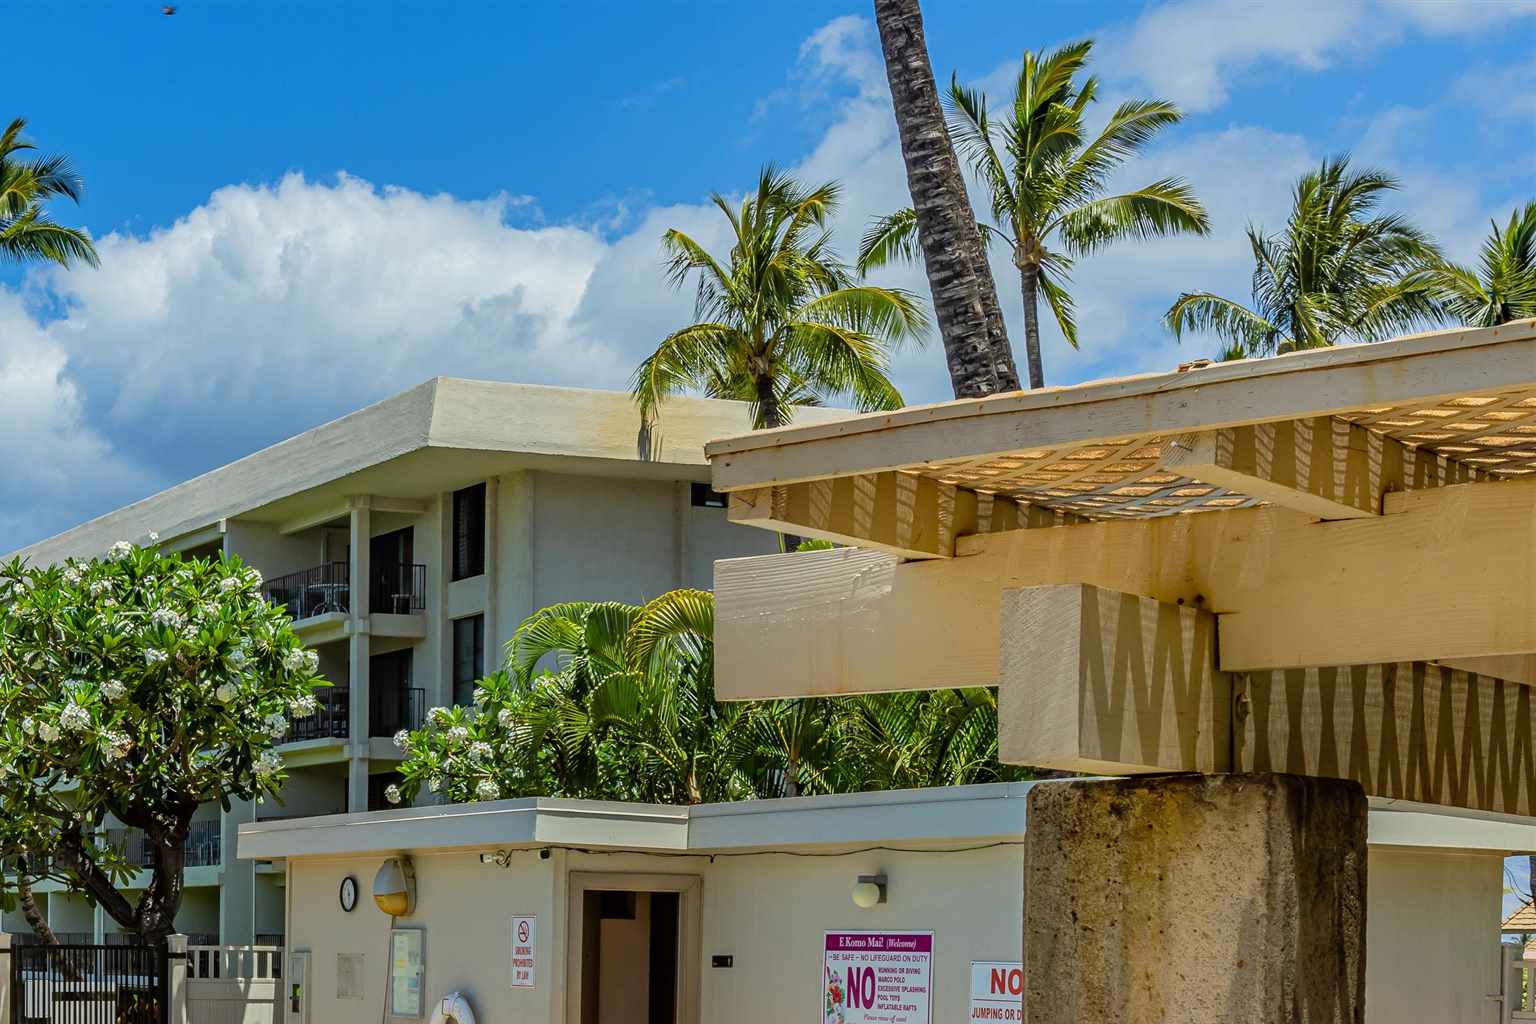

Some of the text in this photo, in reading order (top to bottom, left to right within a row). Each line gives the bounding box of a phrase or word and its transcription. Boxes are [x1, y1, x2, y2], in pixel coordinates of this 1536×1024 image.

[845, 936, 867, 948] Komo
[886, 937, 917, 951] (Welcome)
[841, 953, 854, 961] SAFE
[860, 953, 869, 962] NO
[870, 953, 902, 963] LIFEGUARD
[902, 954, 912, 963] ON
[912, 954, 929, 963] DUTY
[990, 968, 1024, 996] NO
[846, 966, 876, 1010] NO
[877, 985, 927, 994] EXCESSIVE SPLASHING
[877, 994, 901, 1003] POOL TOYS
[877, 1003, 918, 1012] INFLATABLE RAFTS
[971, 1007, 1003, 1019] JUMPING
[1004, 1008, 1015, 1020] OR
